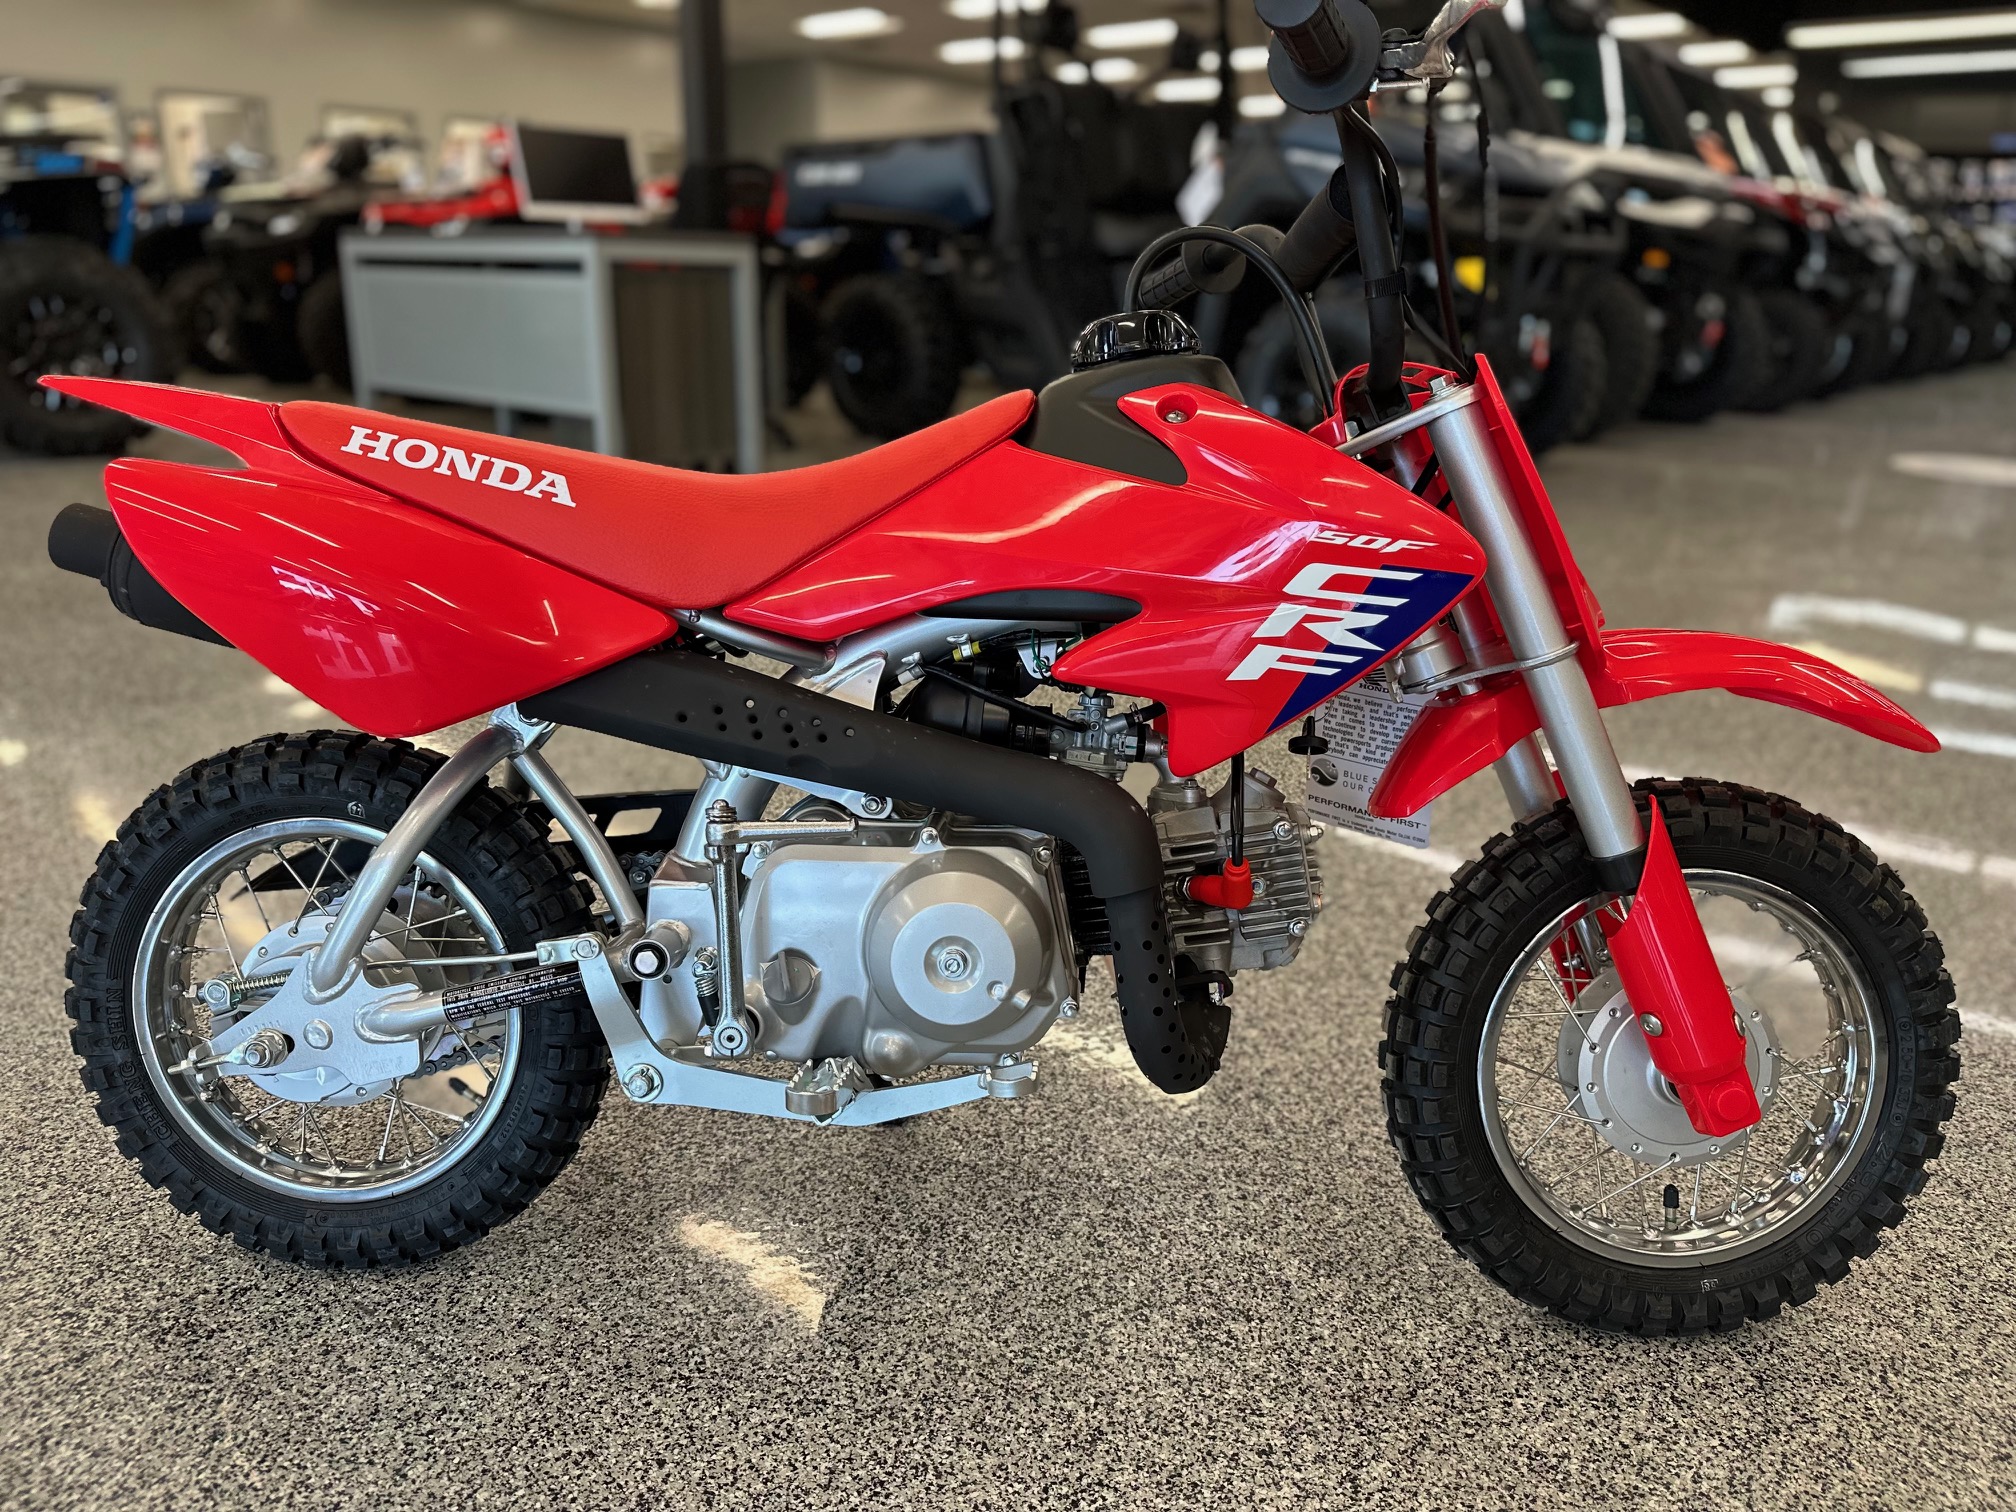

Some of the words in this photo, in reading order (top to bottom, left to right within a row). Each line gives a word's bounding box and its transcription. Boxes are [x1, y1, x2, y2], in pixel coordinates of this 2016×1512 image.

[340, 426, 576, 508] HONDA
[1310, 530, 1440, 553] 50F
[1359, 683, 1390, 693] HOND
[1338, 700, 1365, 712] leadership,
[1384, 710, 1398, 718] that's
[1365, 699, 1383, 708] believe
[1396, 706, 1418, 715] perform
[1342, 708, 1358, 718] taking
[1370, 714, 1396, 725] leadership
[1323, 724, 1354, 737] technologies
[1335, 721, 1356, 730] continue
[1370, 729, 1390, 739] develop
[1322, 731, 1337, 740] future
[1341, 736, 1371, 748] powersports
[1335, 741, 1349, 749] that's
[1366, 748, 1376, 756] kind
[1343, 770, 1368, 783] BLUE
[1343, 781, 1364, 792] OUR
[106, 988, 129, 1050] SHIN
[120, 1060, 173, 1140] CHENG
[1804, 1140, 1895, 1246] 2.50-10
